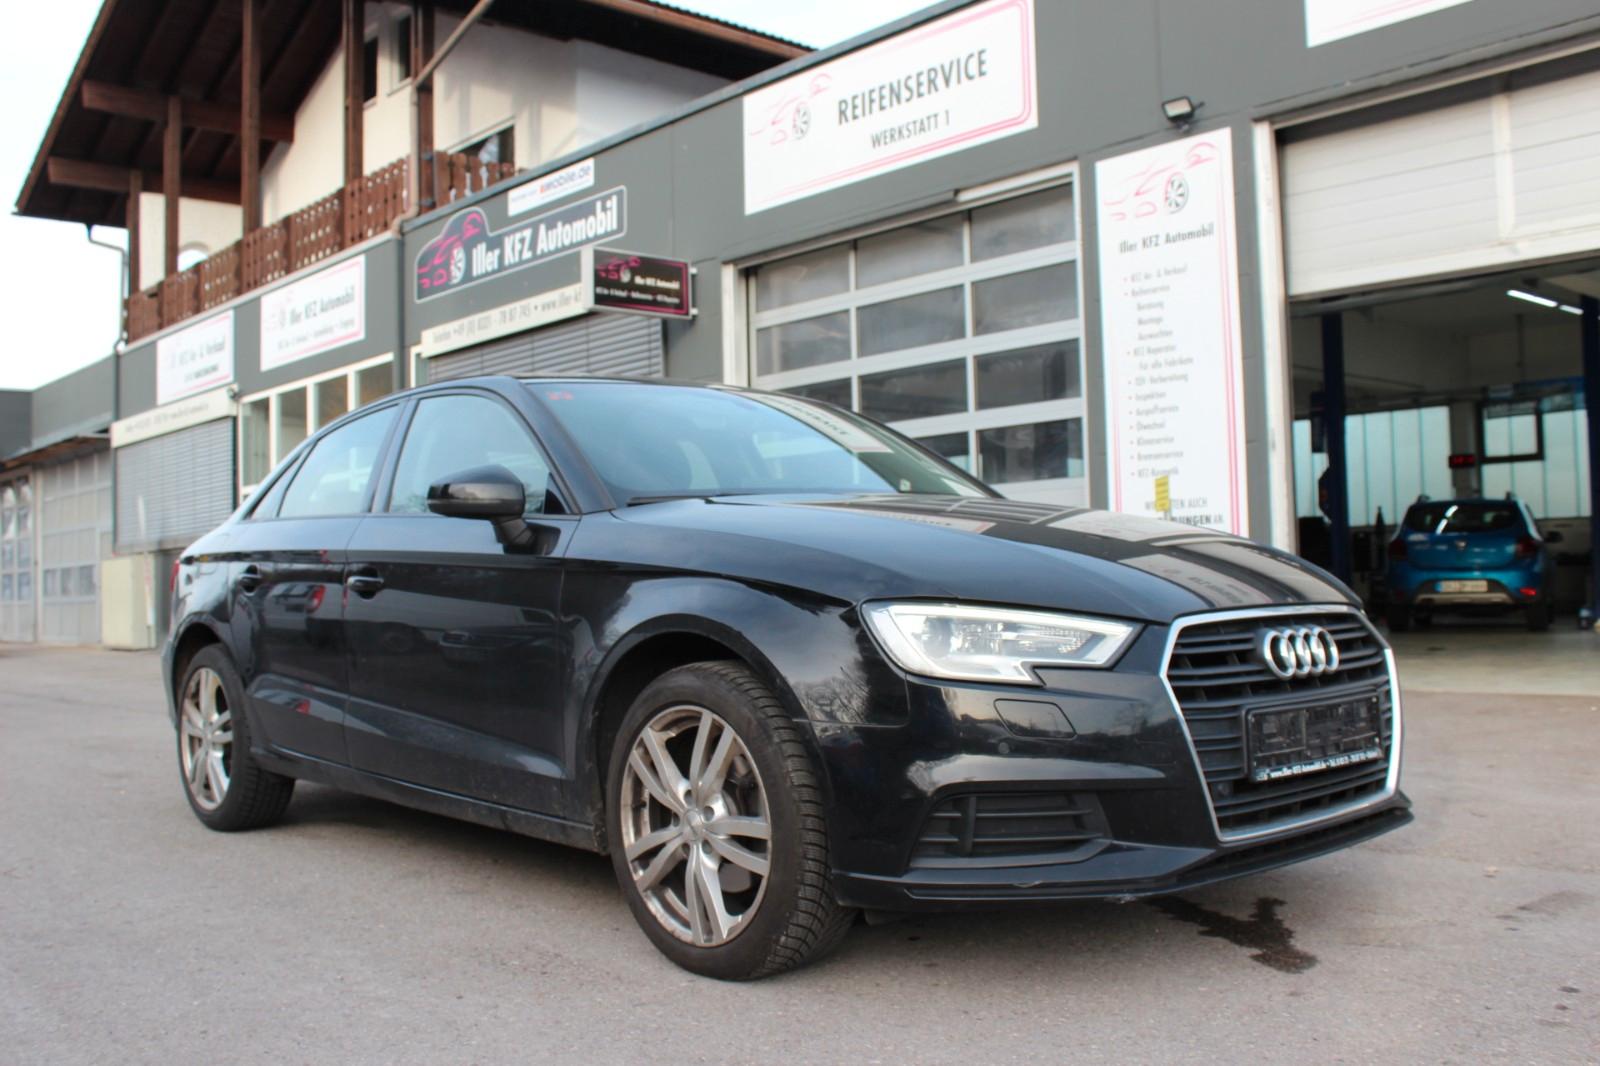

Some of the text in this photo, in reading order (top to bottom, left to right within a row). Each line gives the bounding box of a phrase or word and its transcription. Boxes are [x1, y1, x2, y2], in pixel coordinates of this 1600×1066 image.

[838, 49, 988, 126] REIFENSERVICE
[871, 109, 951, 149] WERKSTATT 1
[472, 194, 618, 277] Iller KFZ Automobil
[1142, 234, 1160, 249] KFZ
[1165, 222, 1215, 244] Automobil
